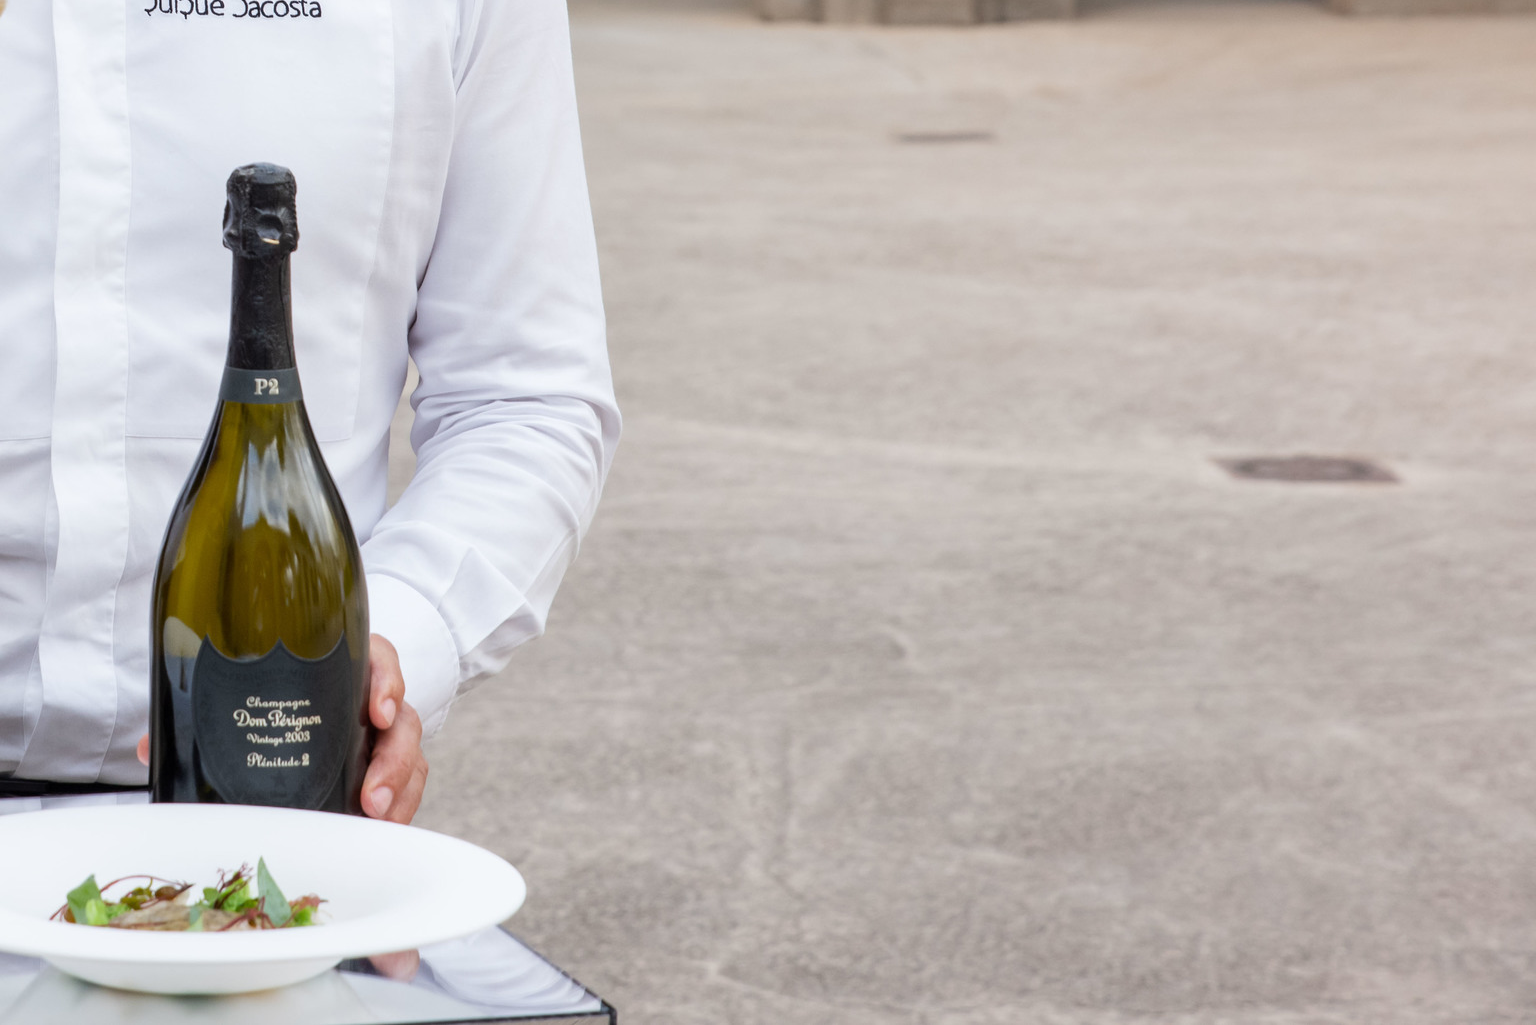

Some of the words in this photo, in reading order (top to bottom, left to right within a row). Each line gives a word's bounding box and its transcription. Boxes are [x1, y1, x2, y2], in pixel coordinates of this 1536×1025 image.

[254, 377, 279, 395] P2
[246, 696, 311, 710] Champagne
[233, 709, 267, 727] Dom
[268, 709, 322, 731] Pérignon
[247, 733, 283, 747] Vintage
[285, 731, 310, 743] 2003
[247, 752, 300, 767] Plénitude
[302, 753, 310, 766] 2
